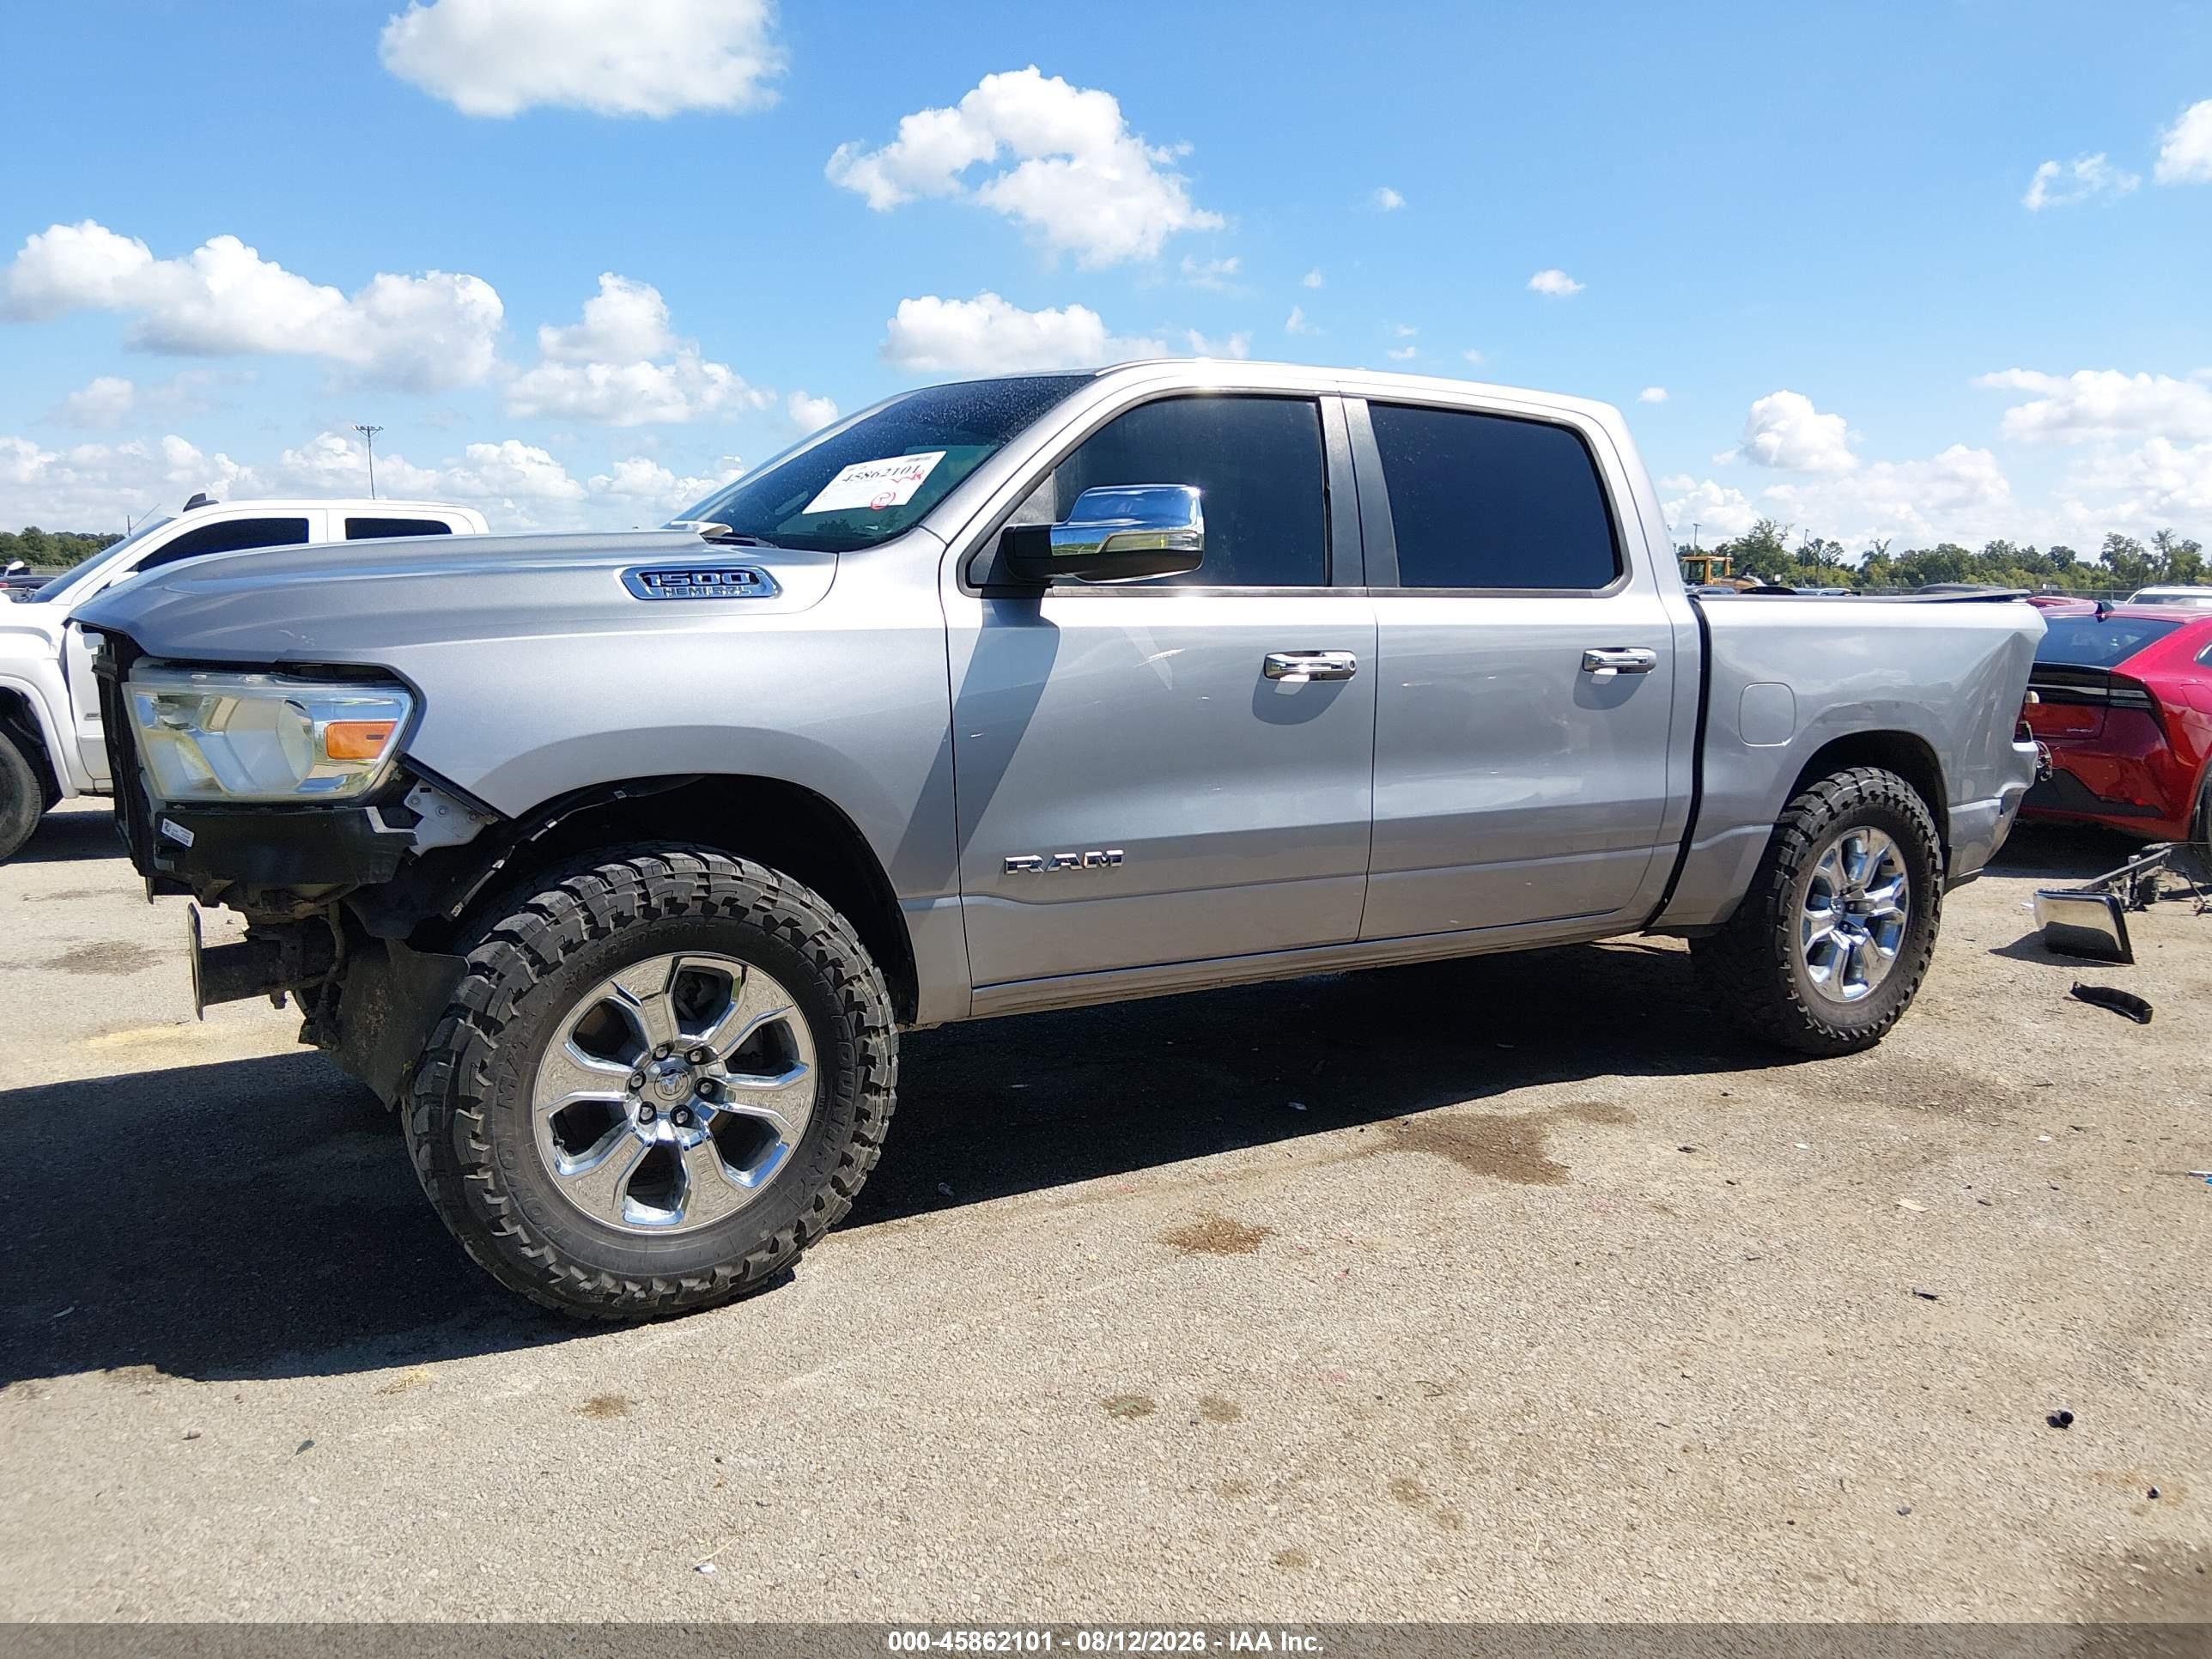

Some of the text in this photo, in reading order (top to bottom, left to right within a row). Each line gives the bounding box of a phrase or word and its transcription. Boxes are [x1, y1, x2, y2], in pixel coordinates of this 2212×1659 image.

[644, 572, 750, 586] 1500
[661, 586, 710, 598] HEMI
[1004, 849, 1125, 875] RAM
